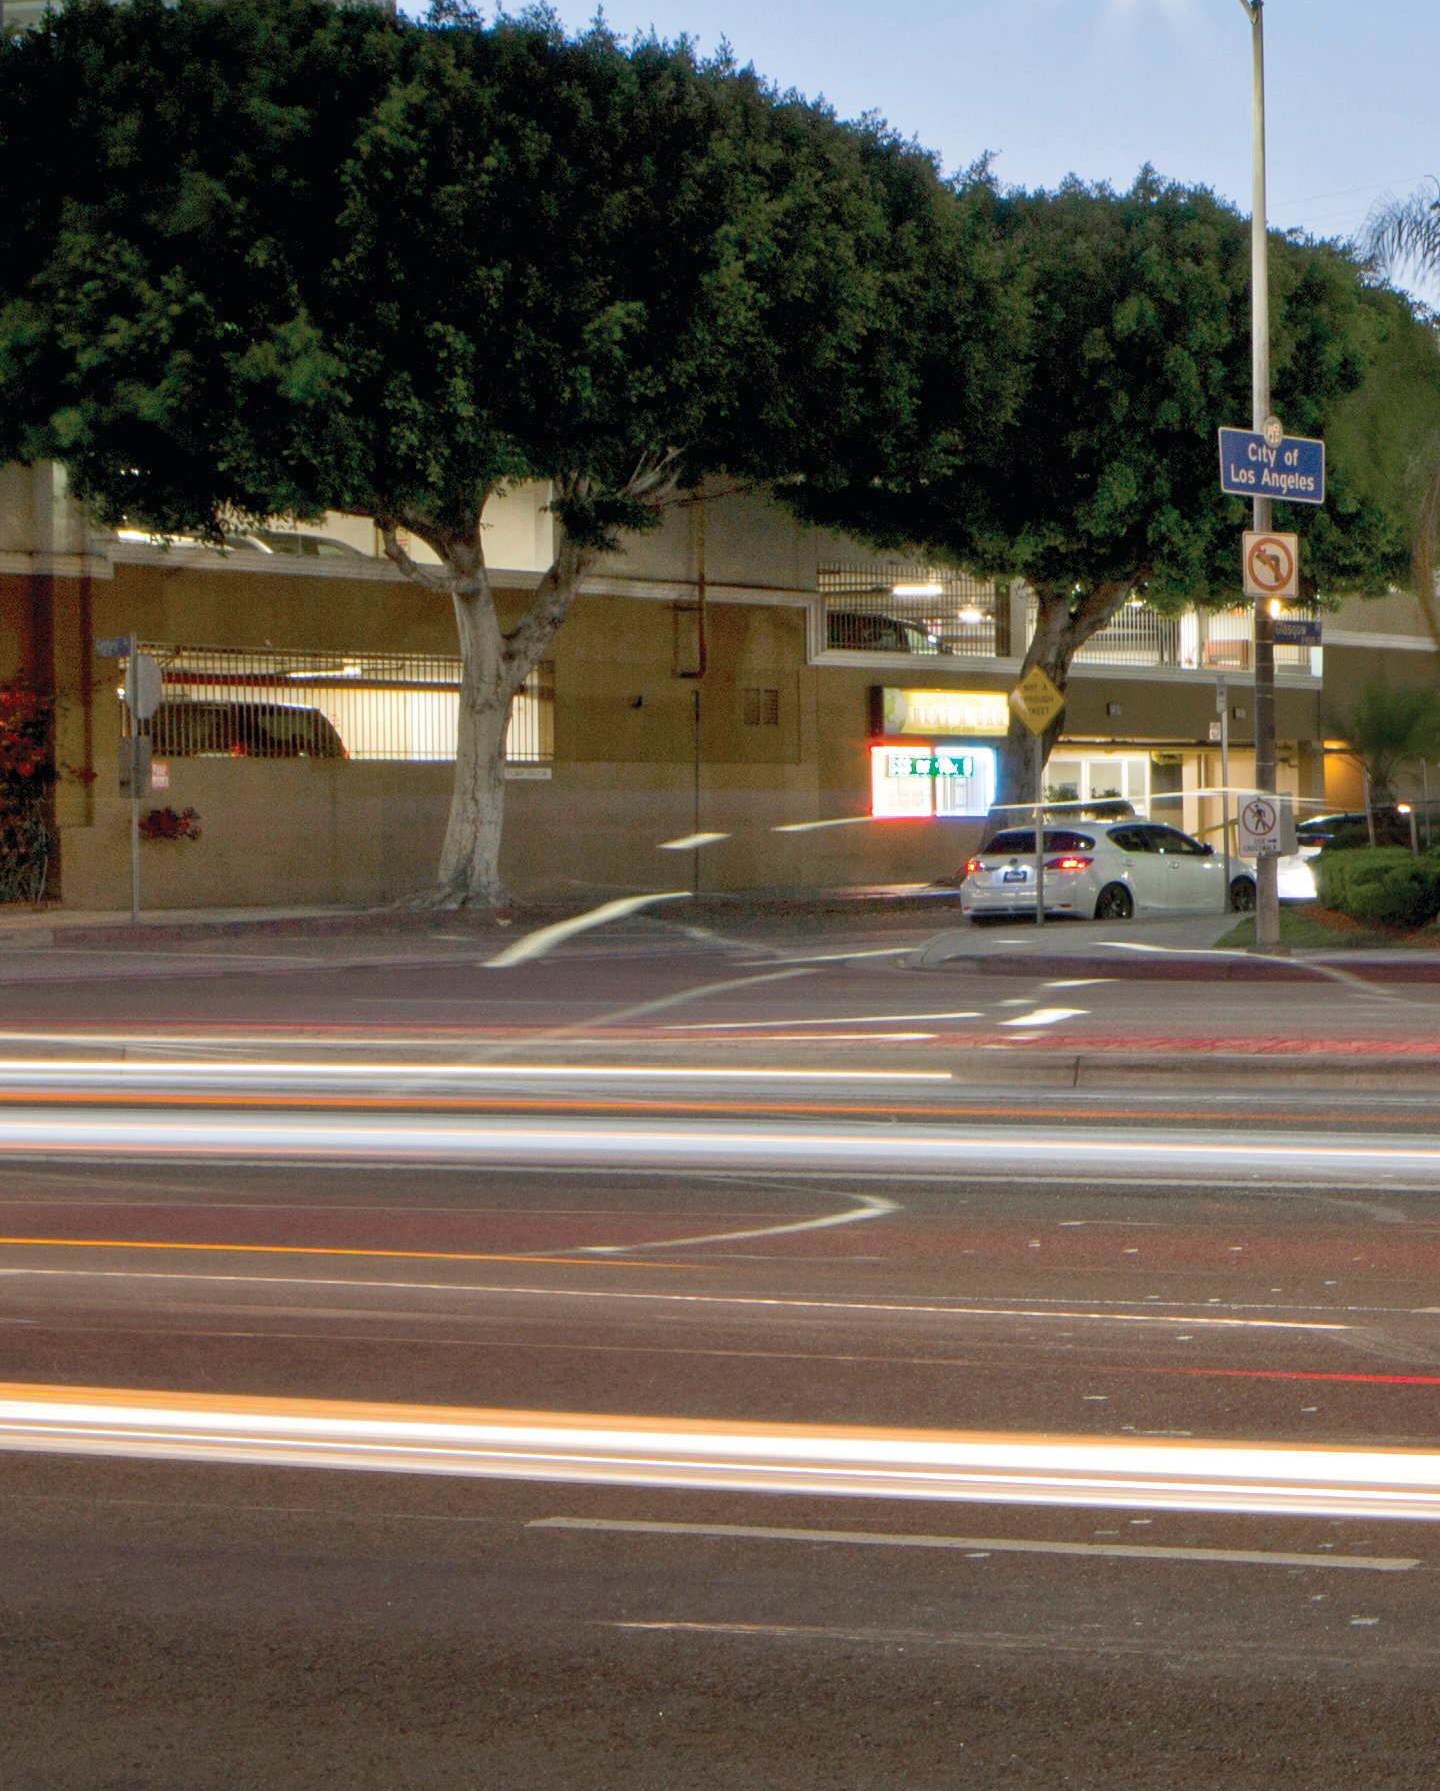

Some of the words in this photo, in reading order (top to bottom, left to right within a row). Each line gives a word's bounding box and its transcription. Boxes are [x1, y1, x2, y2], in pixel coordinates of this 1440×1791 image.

[1248, 442, 1277, 468] City
[1284, 449, 1299, 466] of
[1230, 464, 1256, 485] Los
[1261, 468, 1315, 495] Angeles
